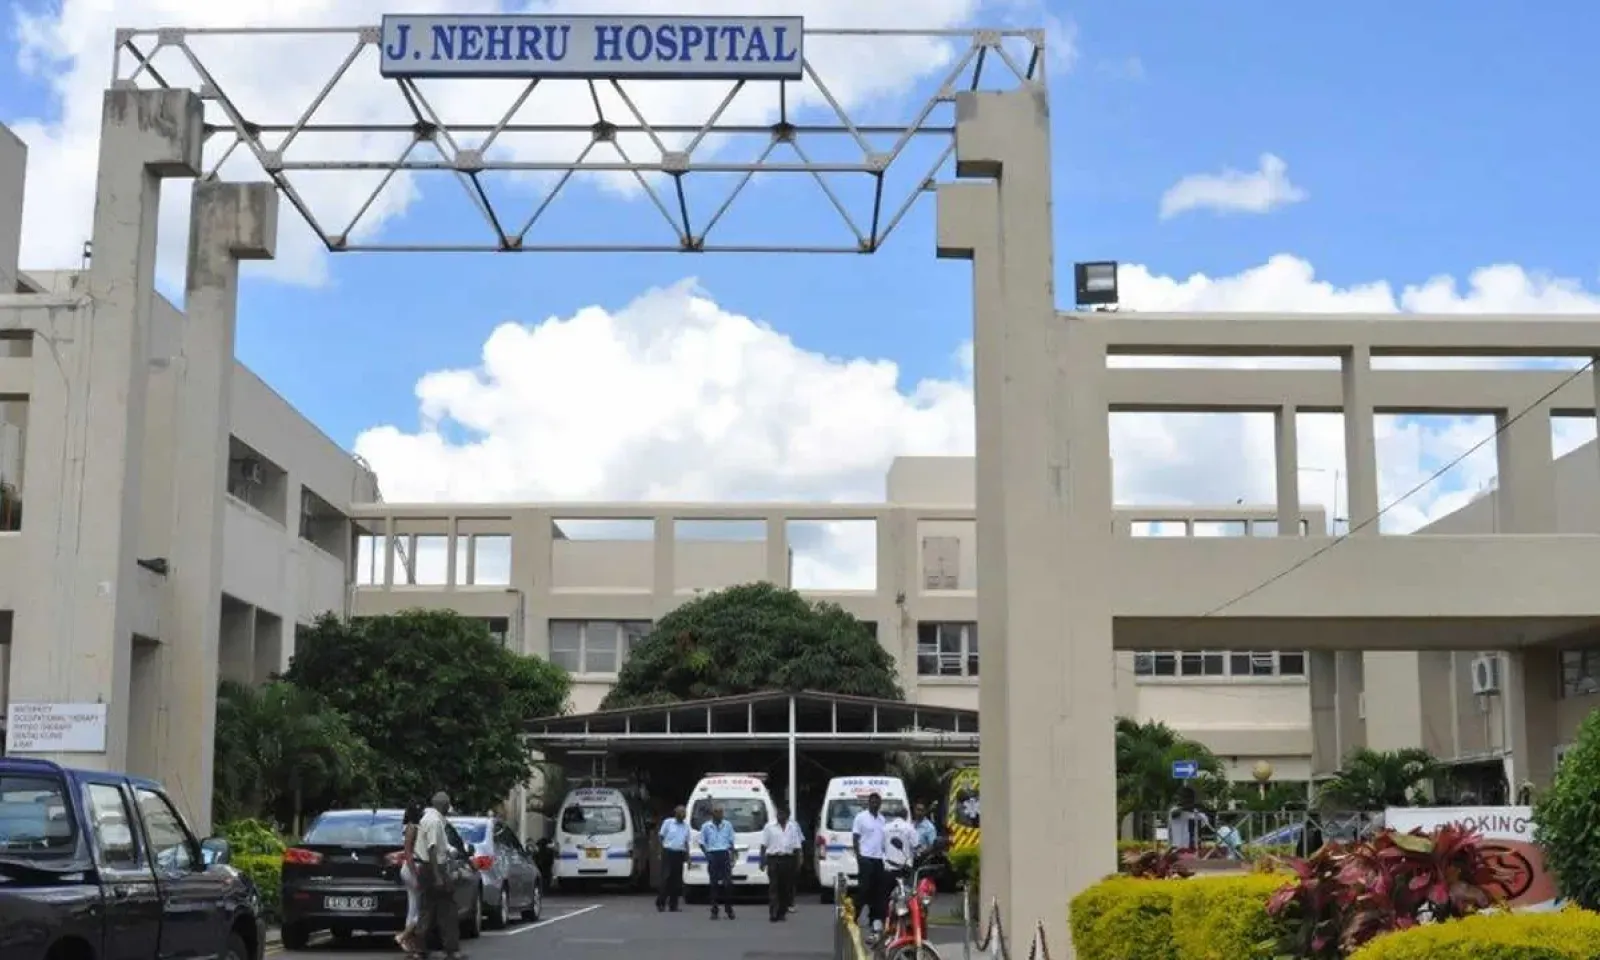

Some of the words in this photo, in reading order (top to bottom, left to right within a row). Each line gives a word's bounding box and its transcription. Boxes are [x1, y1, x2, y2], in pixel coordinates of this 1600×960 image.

[387, 24, 421, 60] J.
[432, 24, 571, 61] NEHRU
[594, 24, 798, 62] HOSPITAL
